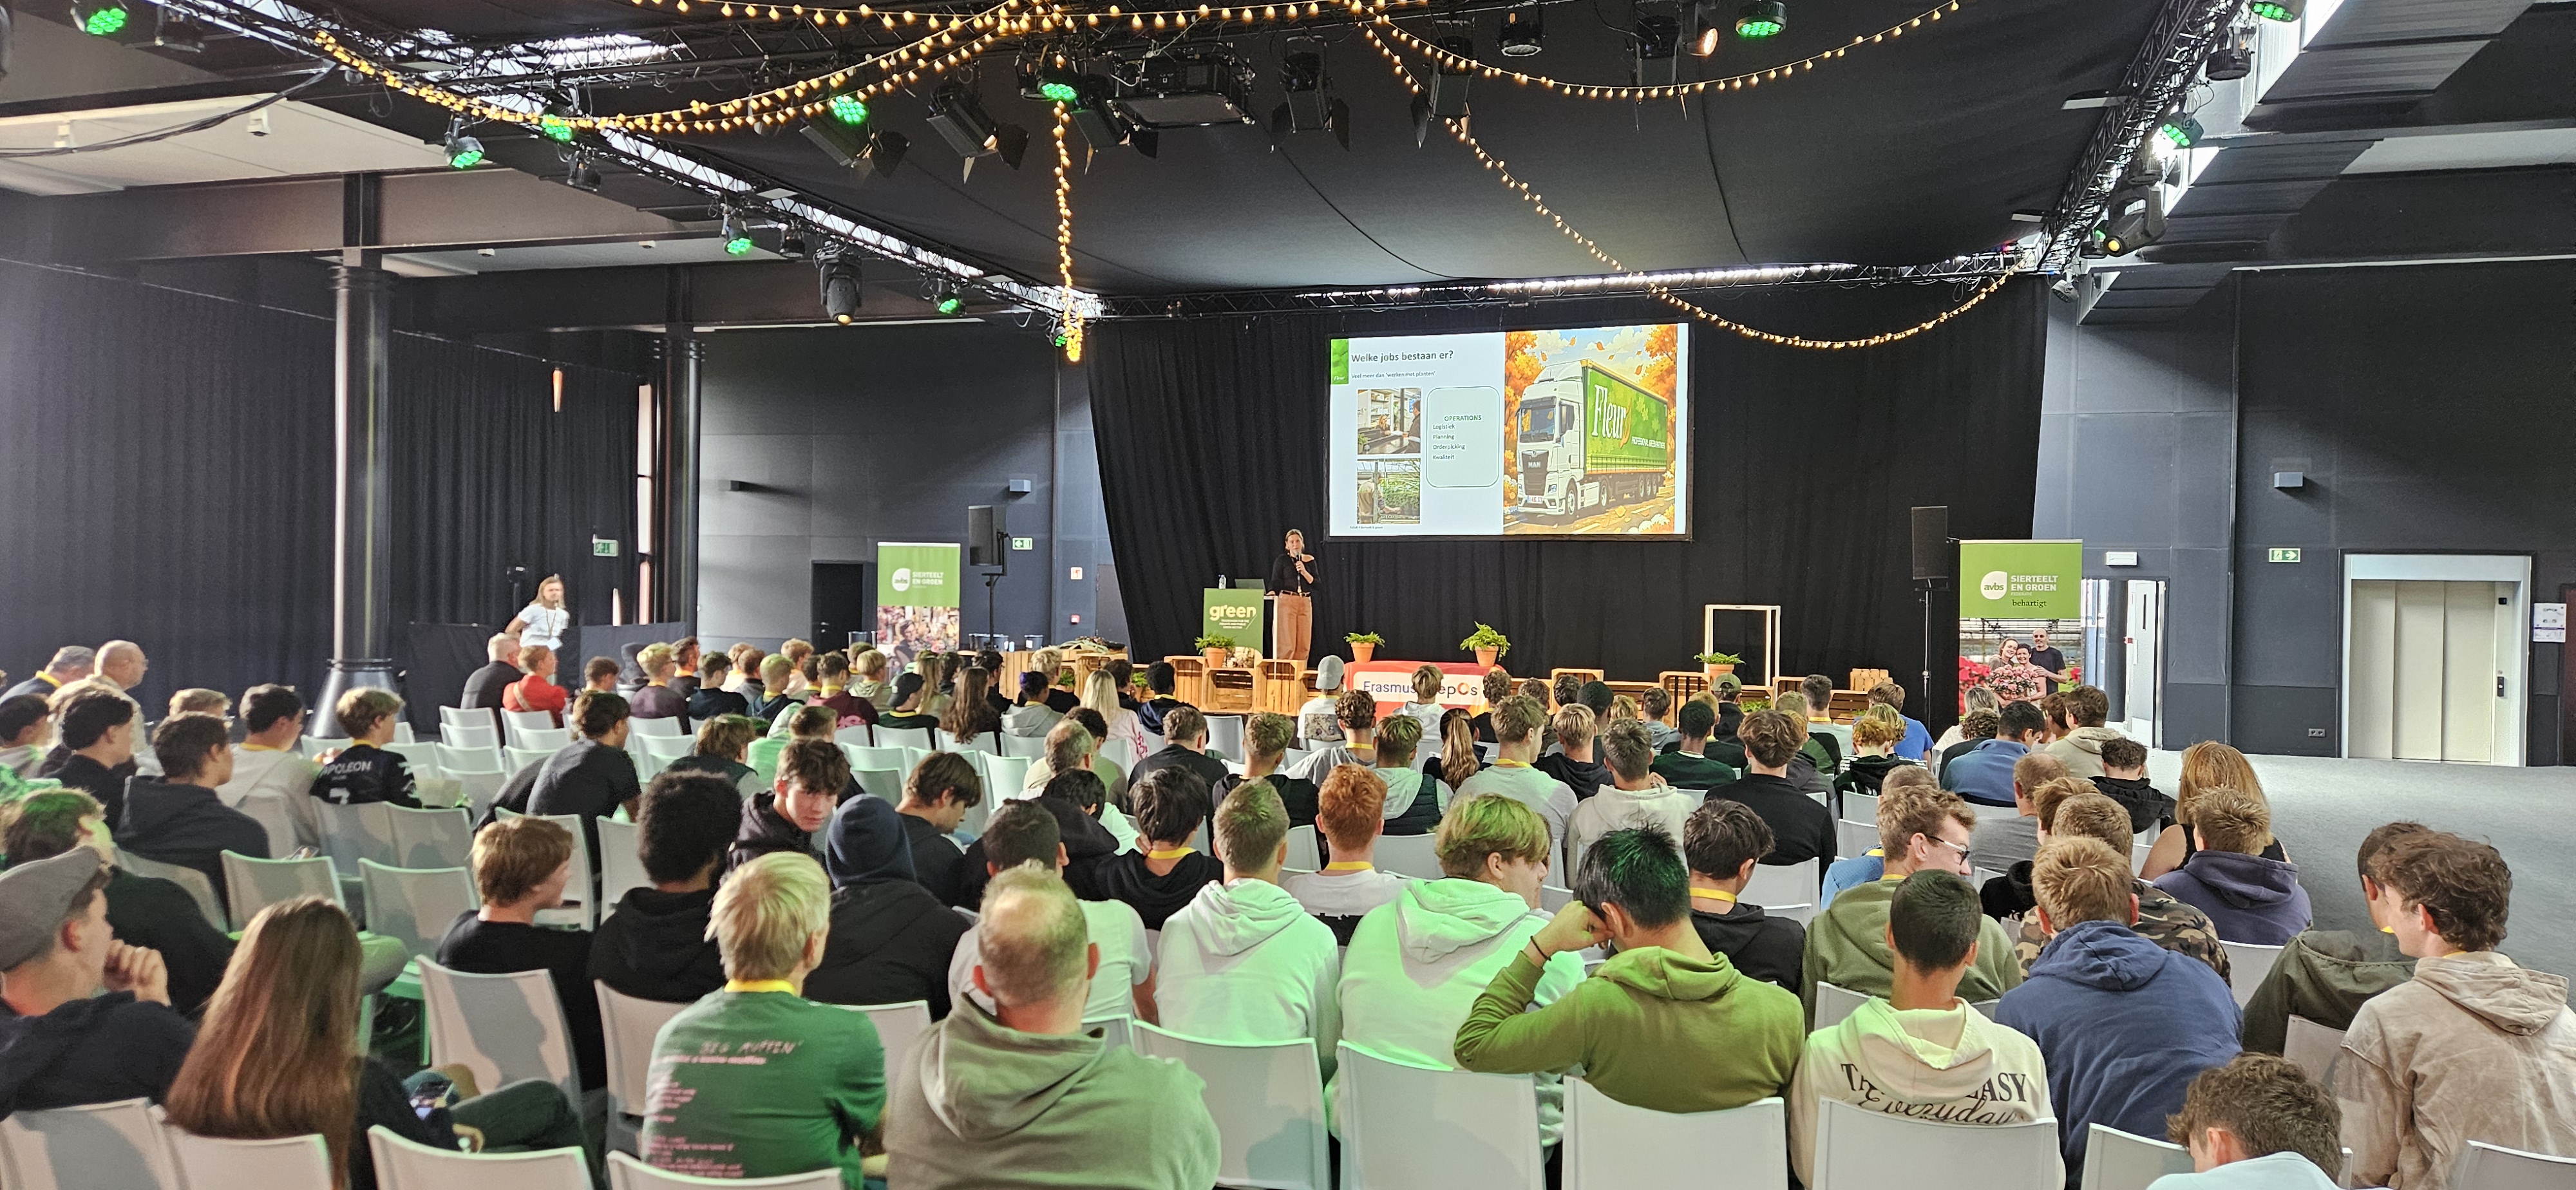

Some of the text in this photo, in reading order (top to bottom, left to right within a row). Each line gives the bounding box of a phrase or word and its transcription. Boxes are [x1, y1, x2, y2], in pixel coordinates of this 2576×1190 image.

[1351, 350, 1454, 363] Welke jobs bestaan er?
[1591, 384, 1627, 440] Fleur
[1984, 582, 2004, 590] avbs
[2012, 599, 2047, 608] behartigt
[1209, 604, 1256, 621] green
